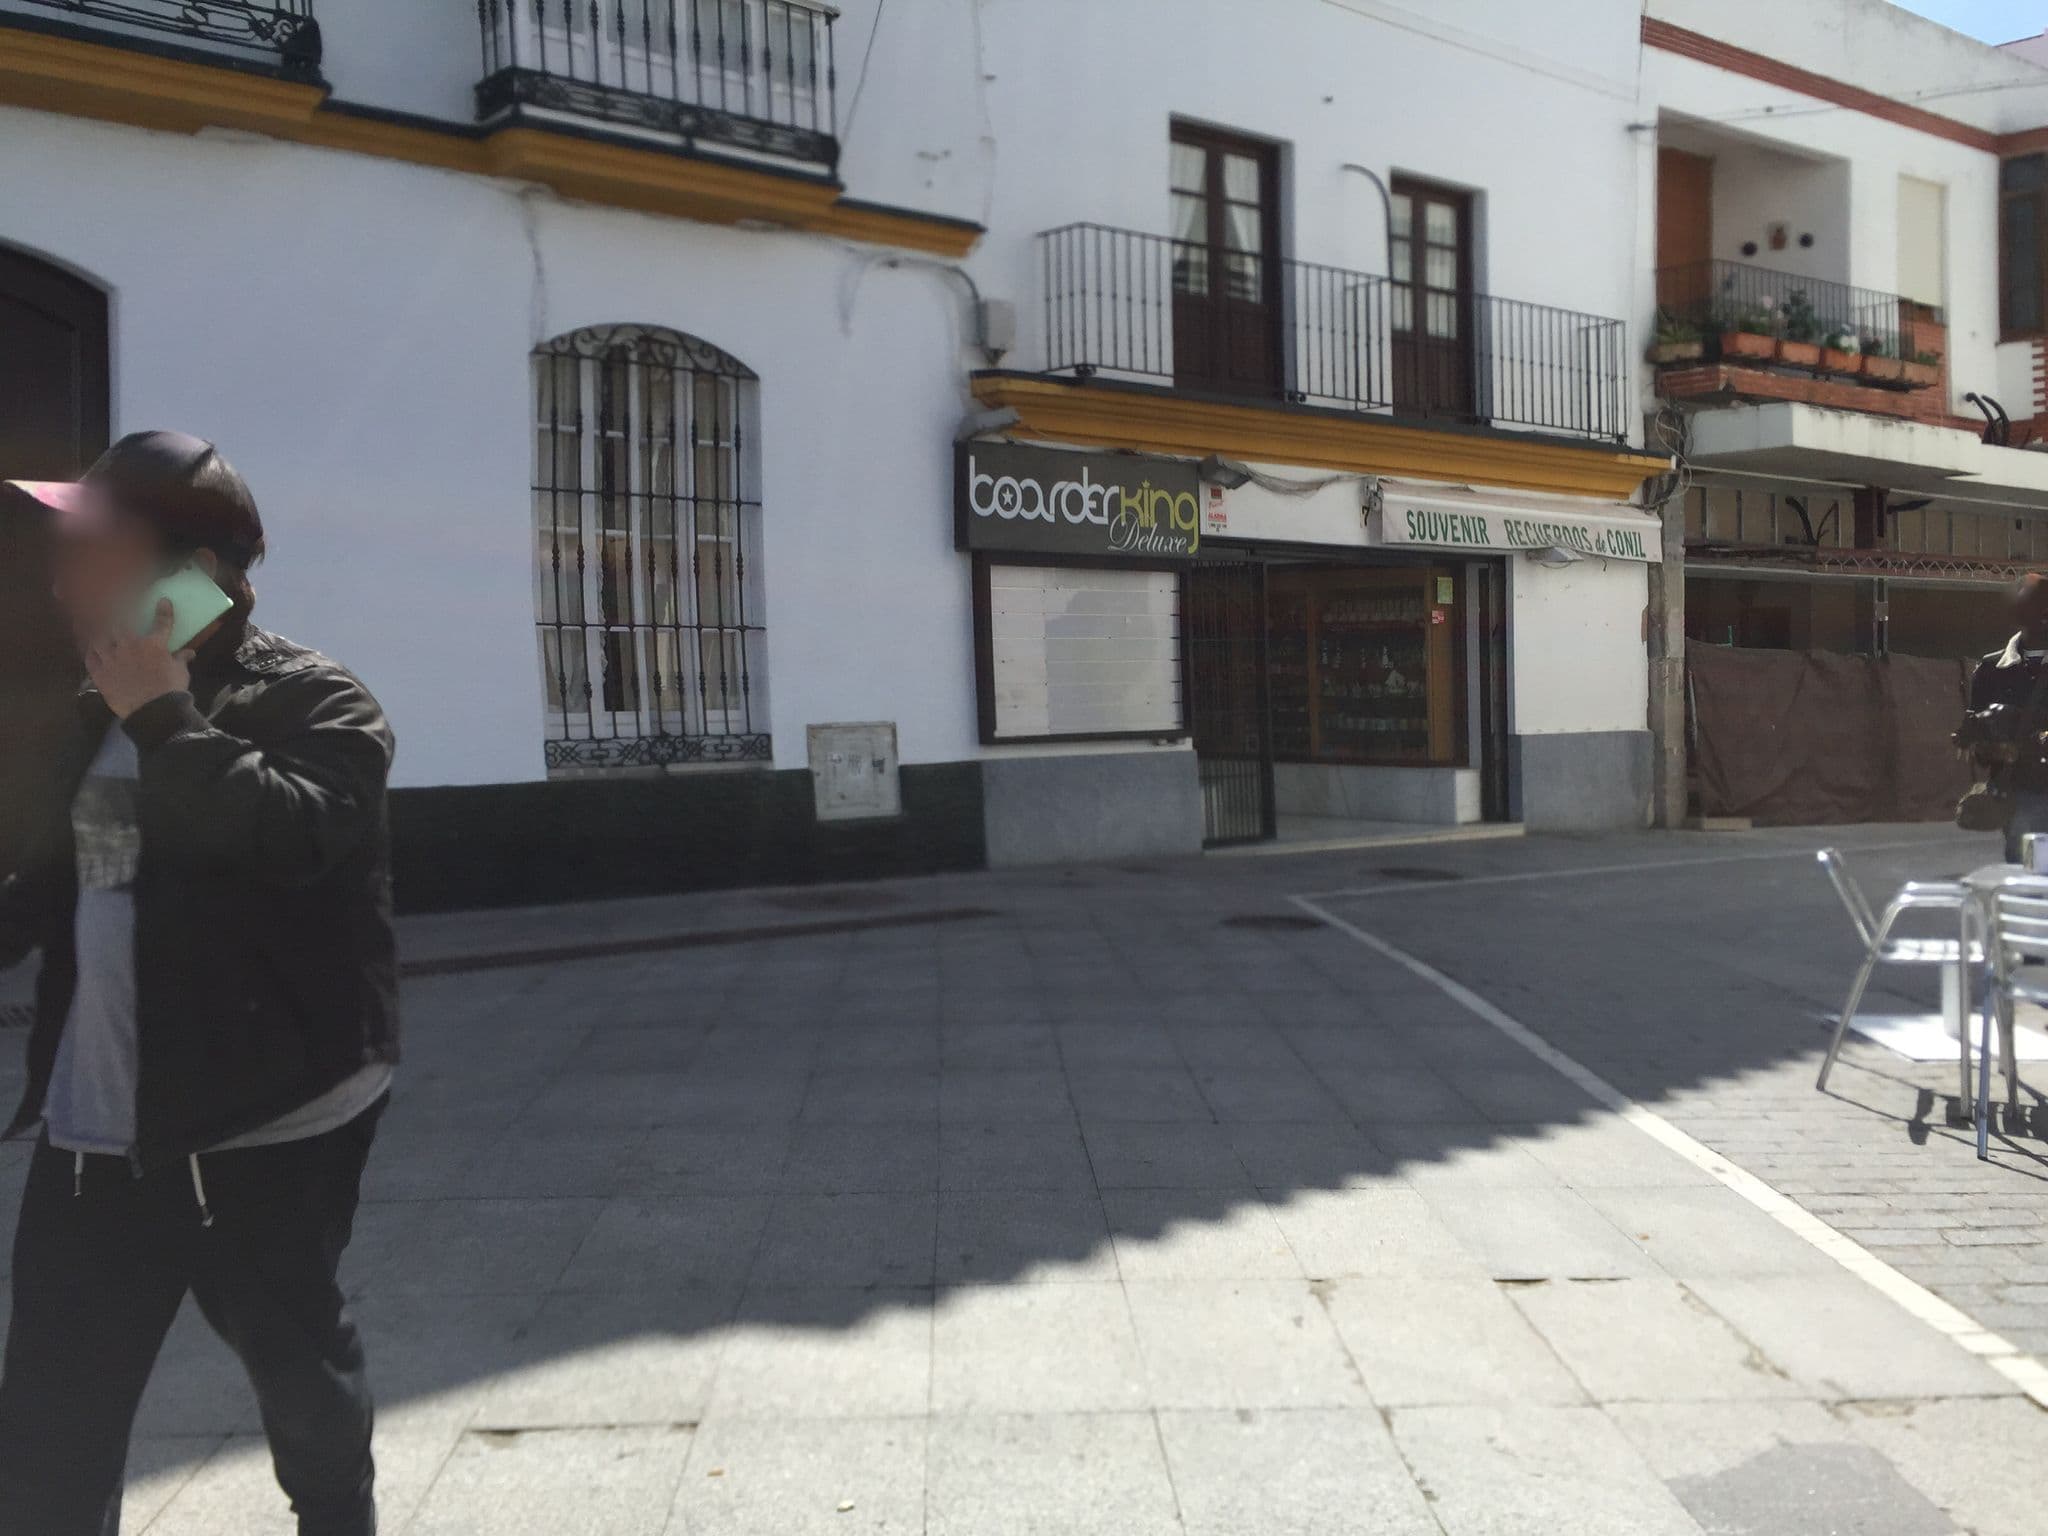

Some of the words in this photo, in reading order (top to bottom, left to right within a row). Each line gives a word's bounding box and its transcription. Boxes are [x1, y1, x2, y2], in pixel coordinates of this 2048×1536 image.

[1107, 511, 1187, 553] Deluxe
[1361, 505, 1370, 527] 7
[1406, 510, 1490, 544] SOUVENIR
[1503, 519, 1592, 551] RECUERDOS
[1595, 531, 1606, 553] de
[1606, 528, 1646, 558] CONIL
